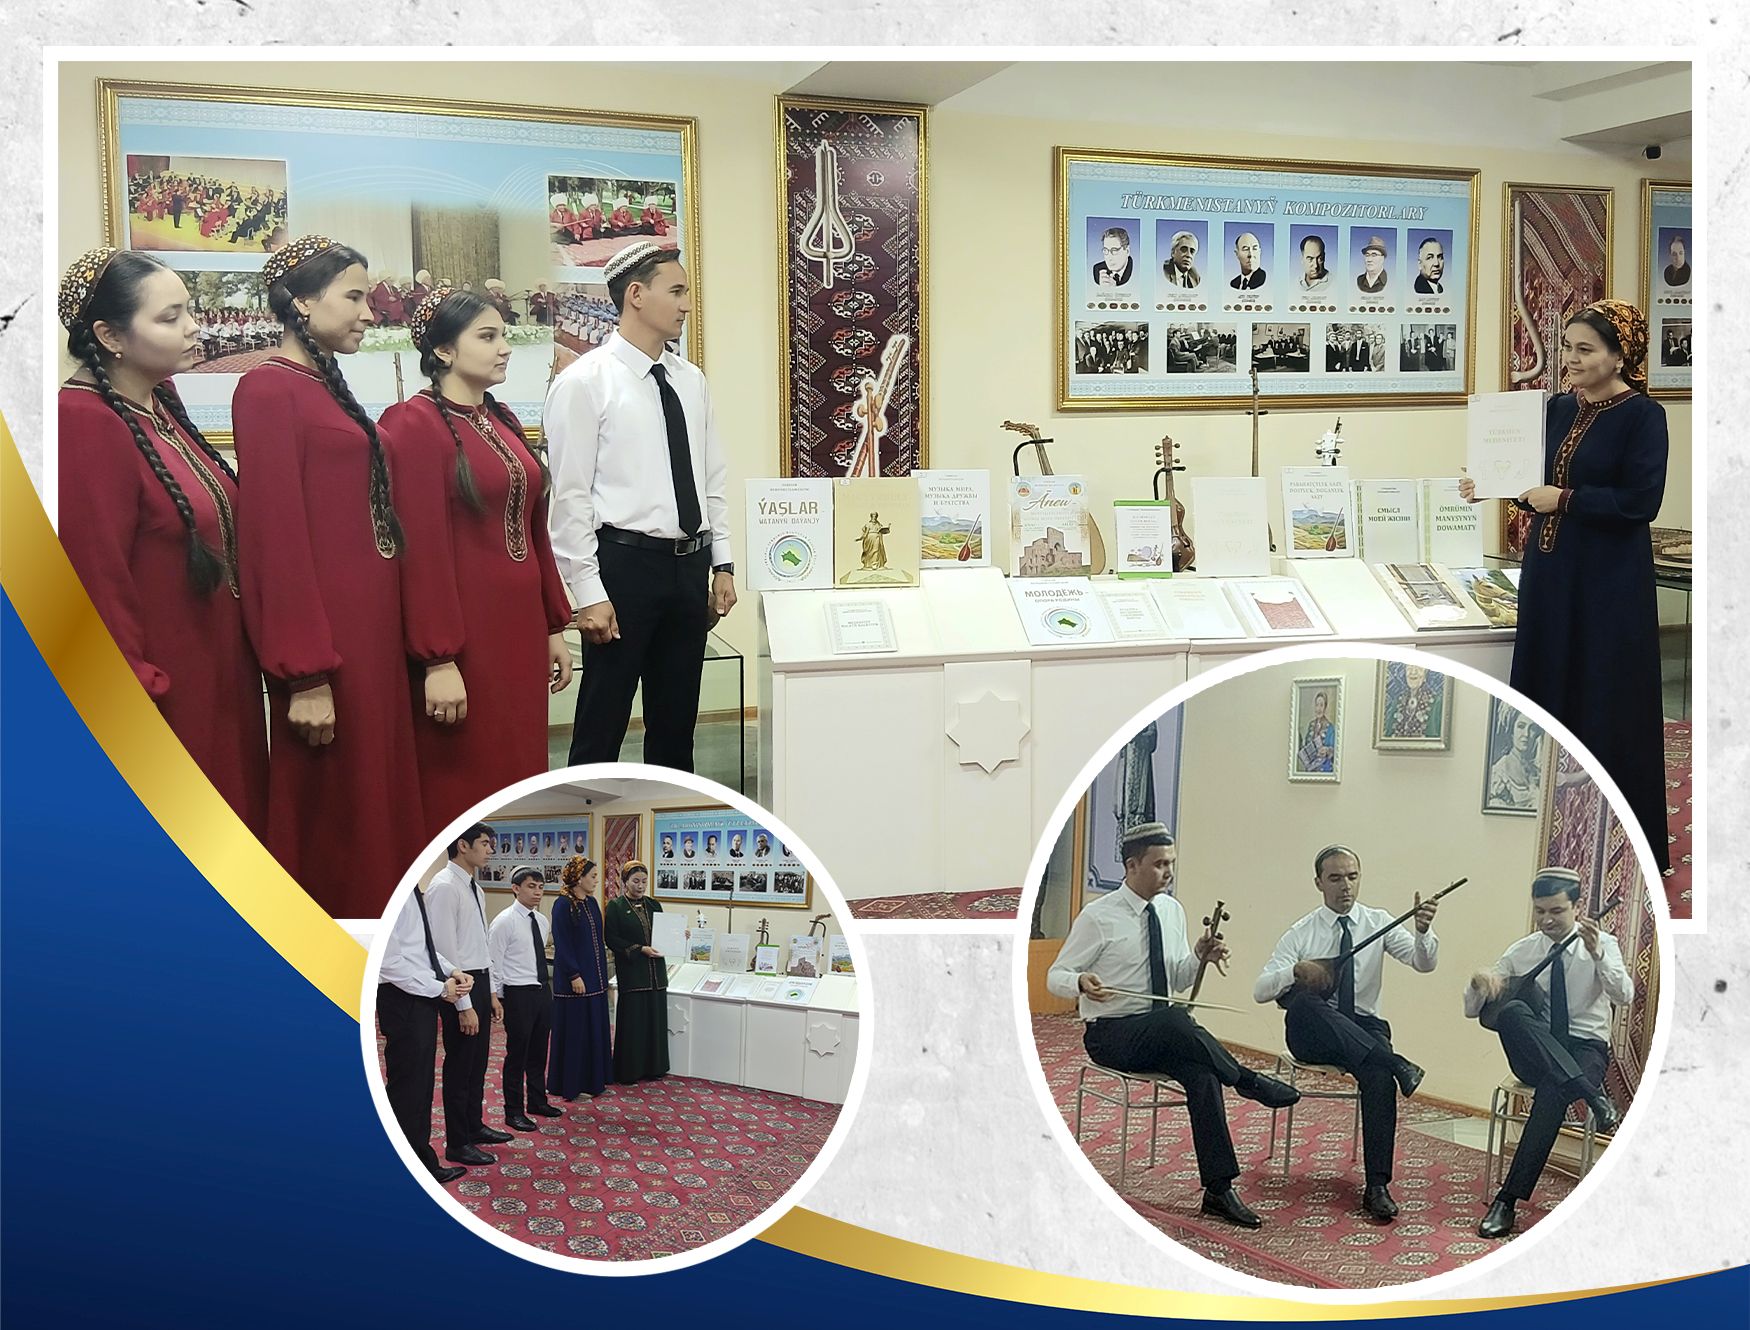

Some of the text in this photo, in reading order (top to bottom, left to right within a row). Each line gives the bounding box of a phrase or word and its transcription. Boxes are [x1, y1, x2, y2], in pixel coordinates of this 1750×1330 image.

[1121, 191, 1428, 220] TÜRKMENISTANYŇ KOMPOZITORLARY
[758, 496, 819, 517] ÝAŞLAR
[1024, 588, 1084, 598] МОЛОДЁЖЬ
